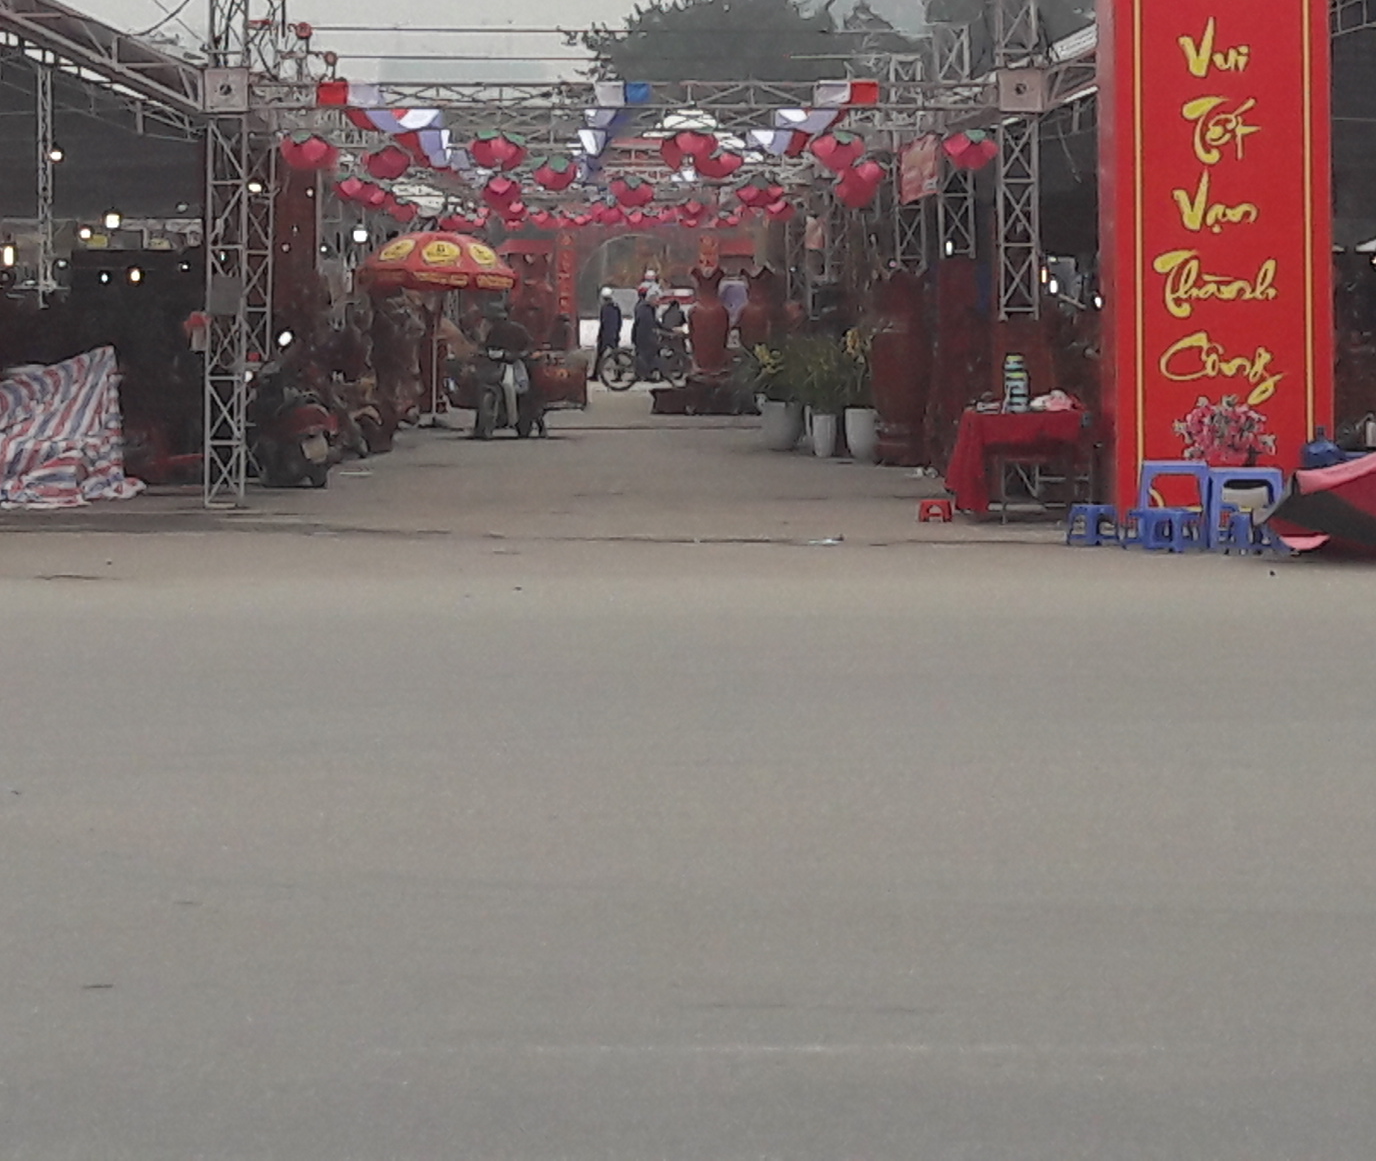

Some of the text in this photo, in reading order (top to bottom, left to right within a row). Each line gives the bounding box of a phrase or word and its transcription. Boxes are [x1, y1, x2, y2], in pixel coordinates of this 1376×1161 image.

[1178, 15, 1250, 78] Vui
[1182, 95, 1262, 165] Tết
[1172, 166, 1259, 233] Vạn
[1160, 330, 1288, 406] Công
